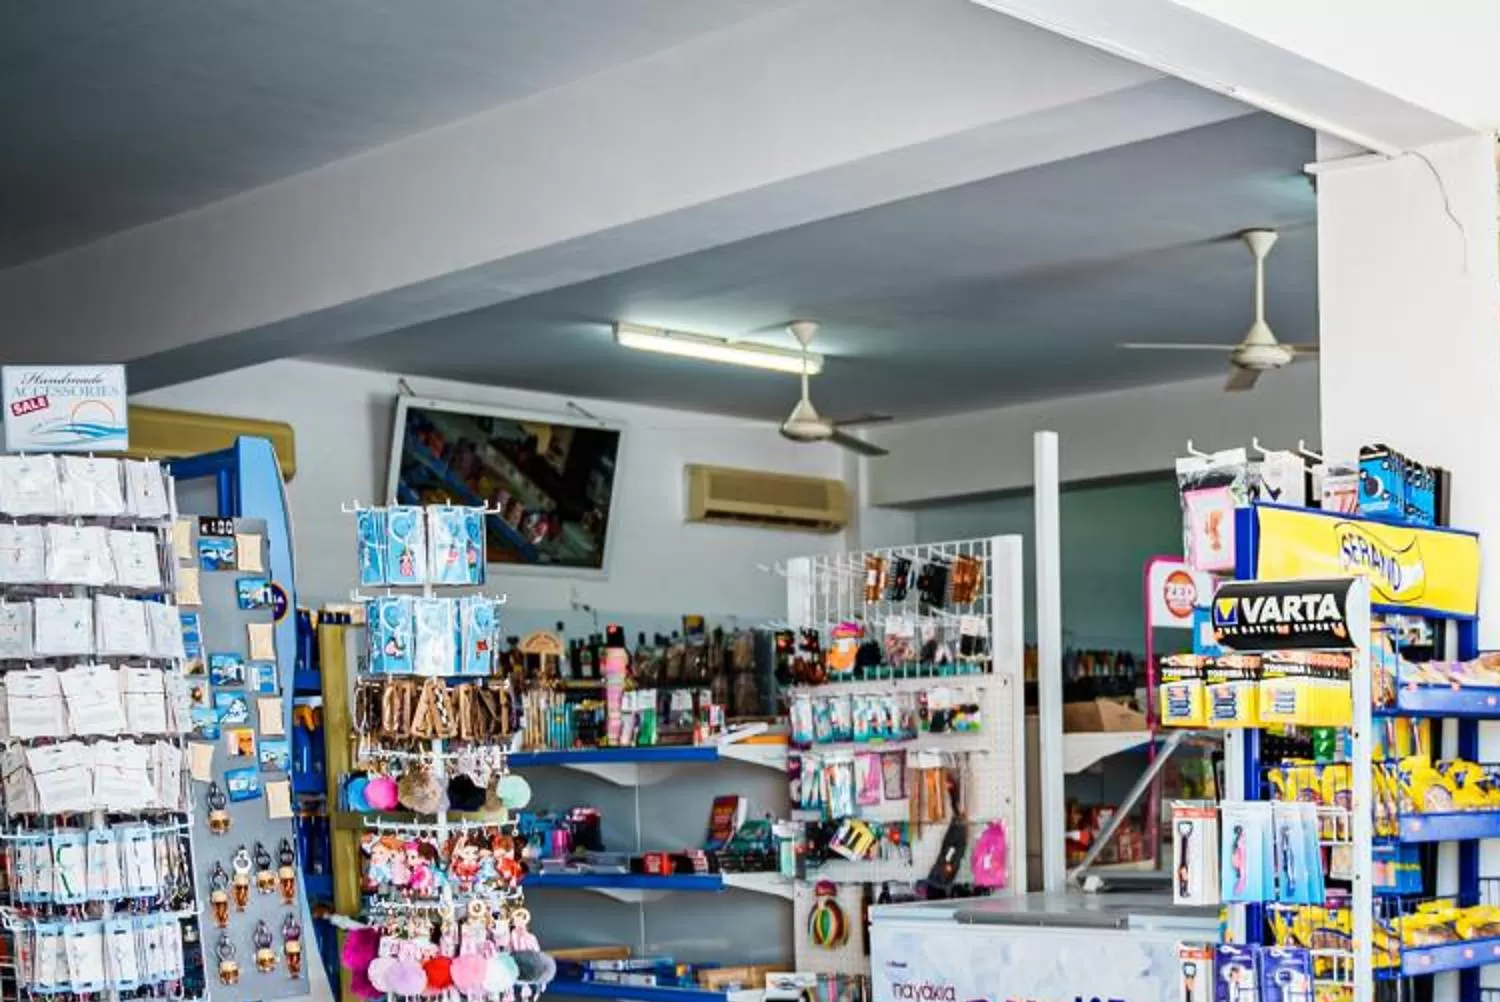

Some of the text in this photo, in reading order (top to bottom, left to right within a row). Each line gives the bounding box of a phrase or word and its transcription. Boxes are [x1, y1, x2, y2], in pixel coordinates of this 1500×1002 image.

[20, 370, 104, 385] Handmade
[12, 385, 119, 397] ACCESSORIES
[12, 395, 46, 415] SALE
[1241, 593, 1342, 623] VARTA
